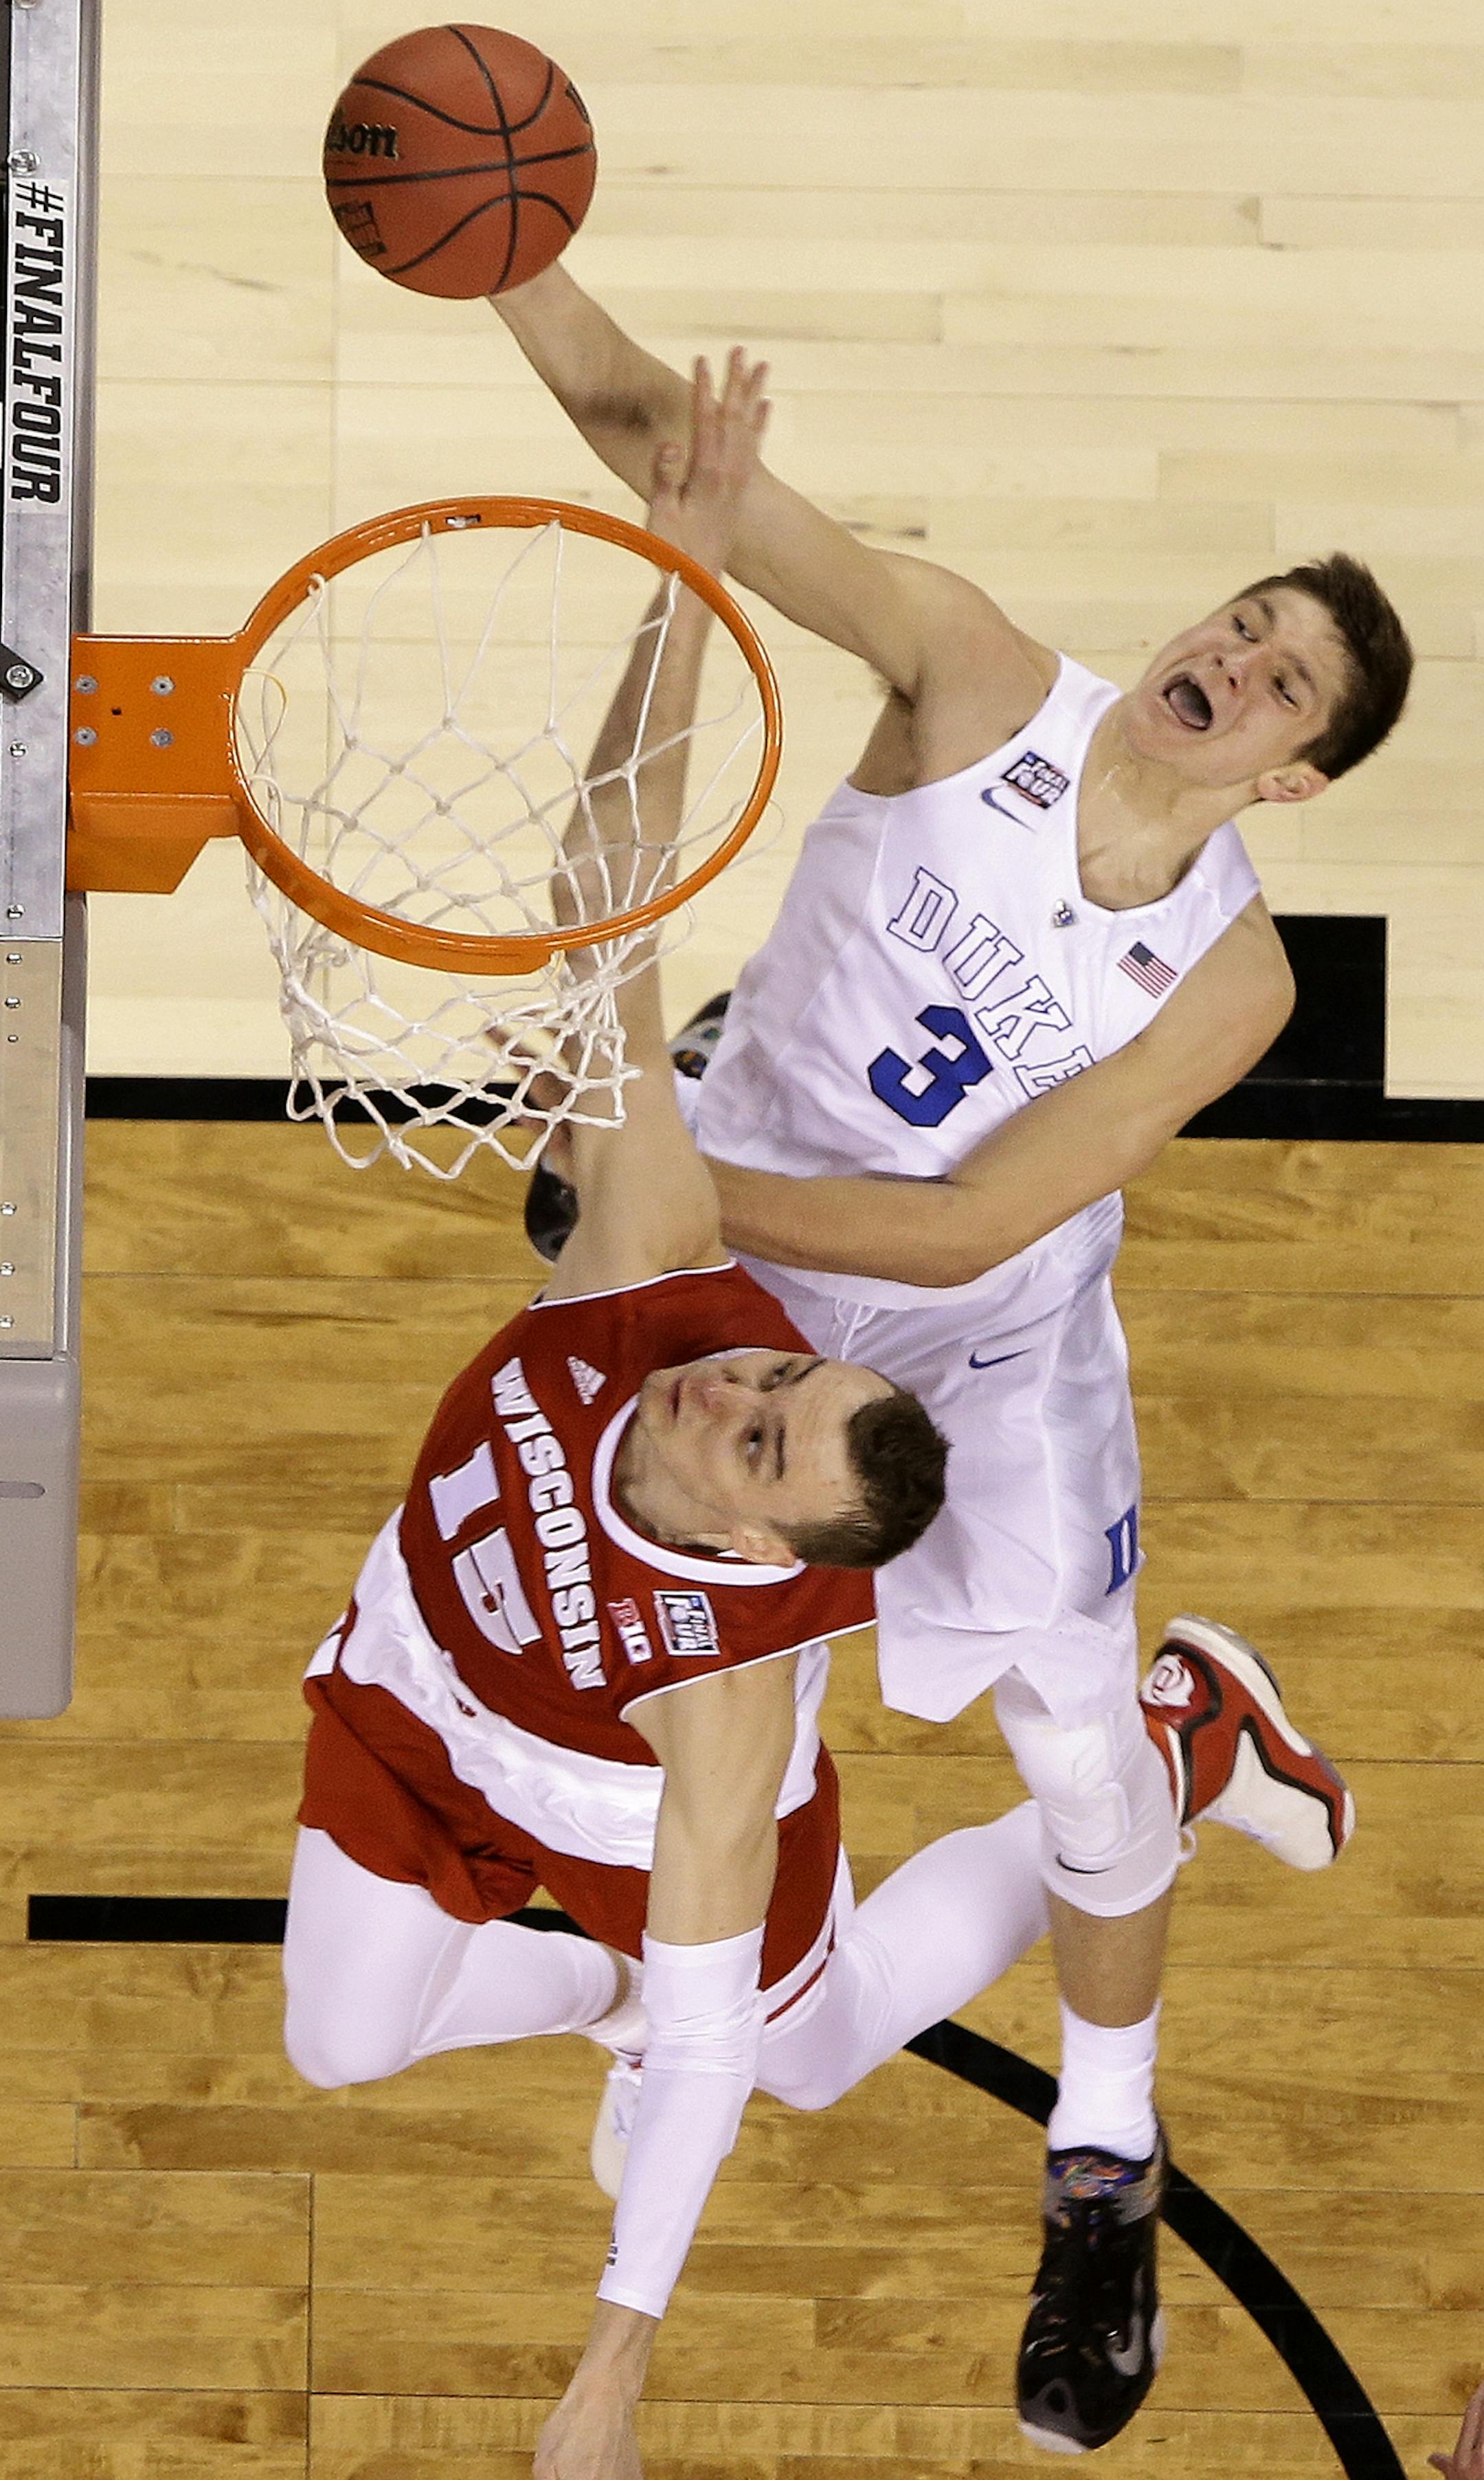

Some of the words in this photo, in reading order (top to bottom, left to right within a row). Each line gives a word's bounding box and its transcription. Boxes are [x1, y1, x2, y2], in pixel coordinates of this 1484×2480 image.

[11, 181, 65, 504] #FINALFOUR
[868, 1004, 994, 1128] 3
[886, 866, 1097, 1099] DUKE
[428, 1440, 543, 1655] 15
[491, 1356, 608, 1691] WISCONSIN
